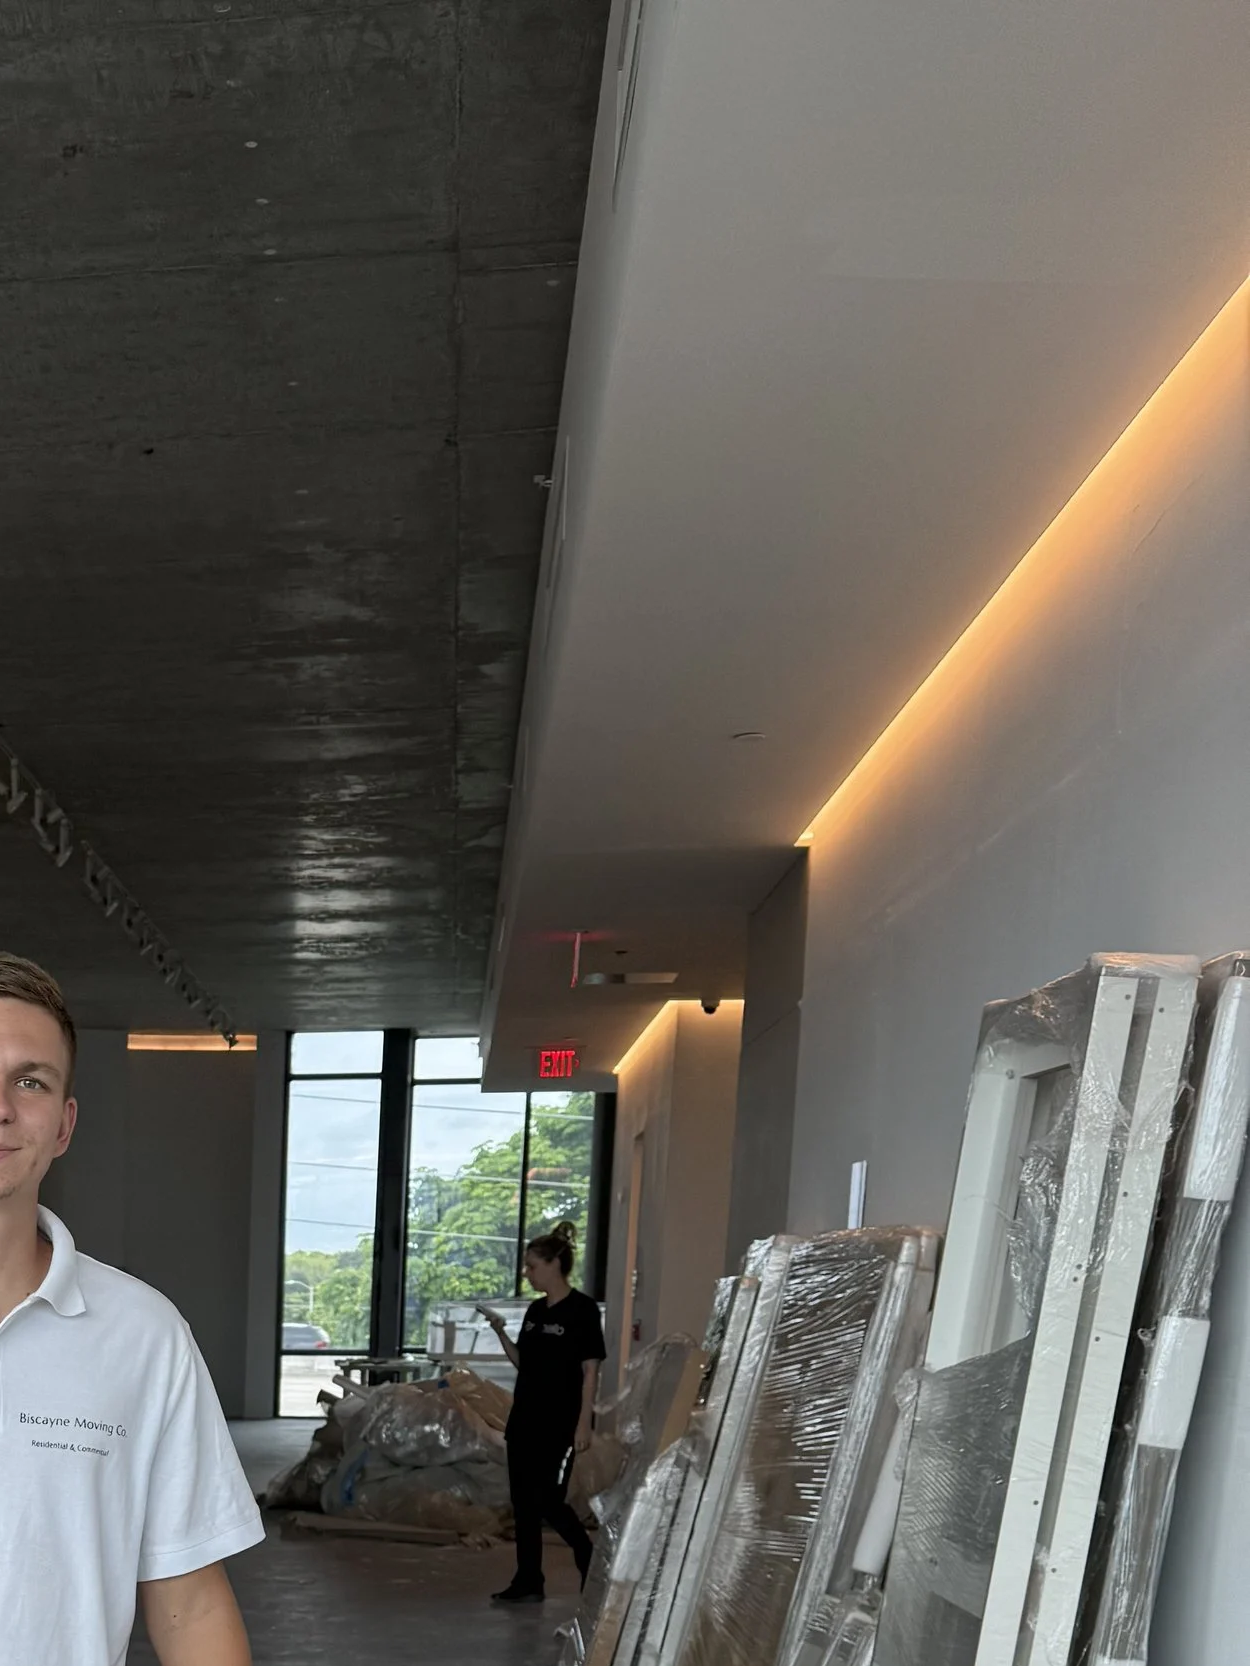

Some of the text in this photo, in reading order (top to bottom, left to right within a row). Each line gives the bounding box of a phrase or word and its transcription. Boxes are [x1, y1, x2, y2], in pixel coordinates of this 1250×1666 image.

[540, 1051, 575, 1077] EXIT
[19, 1412, 128, 1438] Biscayne Moving Co.
[69, 1444, 76, 1452] &
